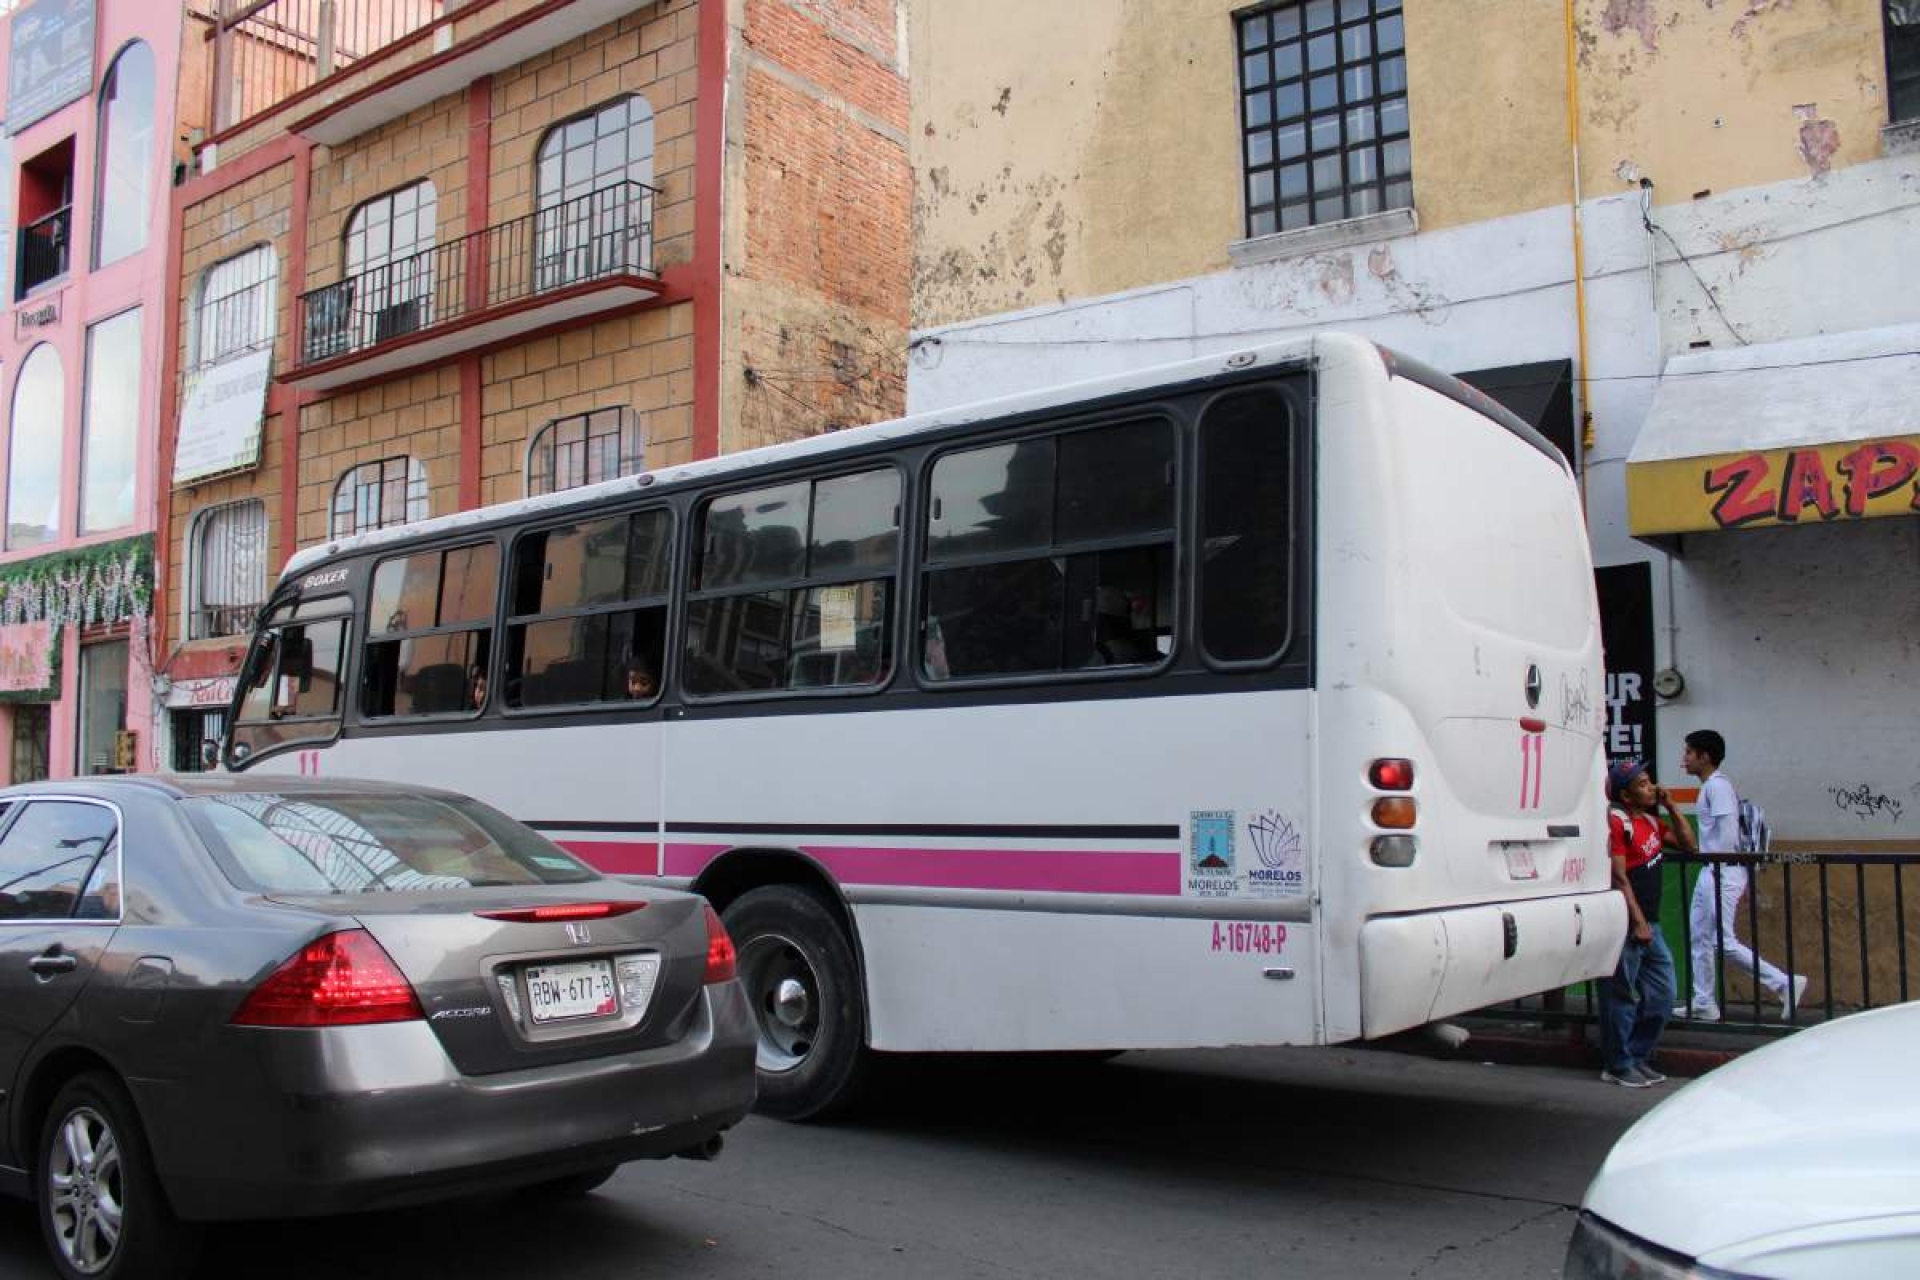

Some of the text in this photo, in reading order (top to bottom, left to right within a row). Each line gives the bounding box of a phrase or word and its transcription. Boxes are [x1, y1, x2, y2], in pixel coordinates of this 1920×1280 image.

[1704, 441, 1920, 528] ZAP
[304, 568, 349, 590] BOXER
[1520, 734, 1542, 809] 11
[1188, 879, 1239, 891] MORELOS
[1249, 869, 1302, 881] MORELOS
[1211, 920, 1287, 954] A-16748-P
